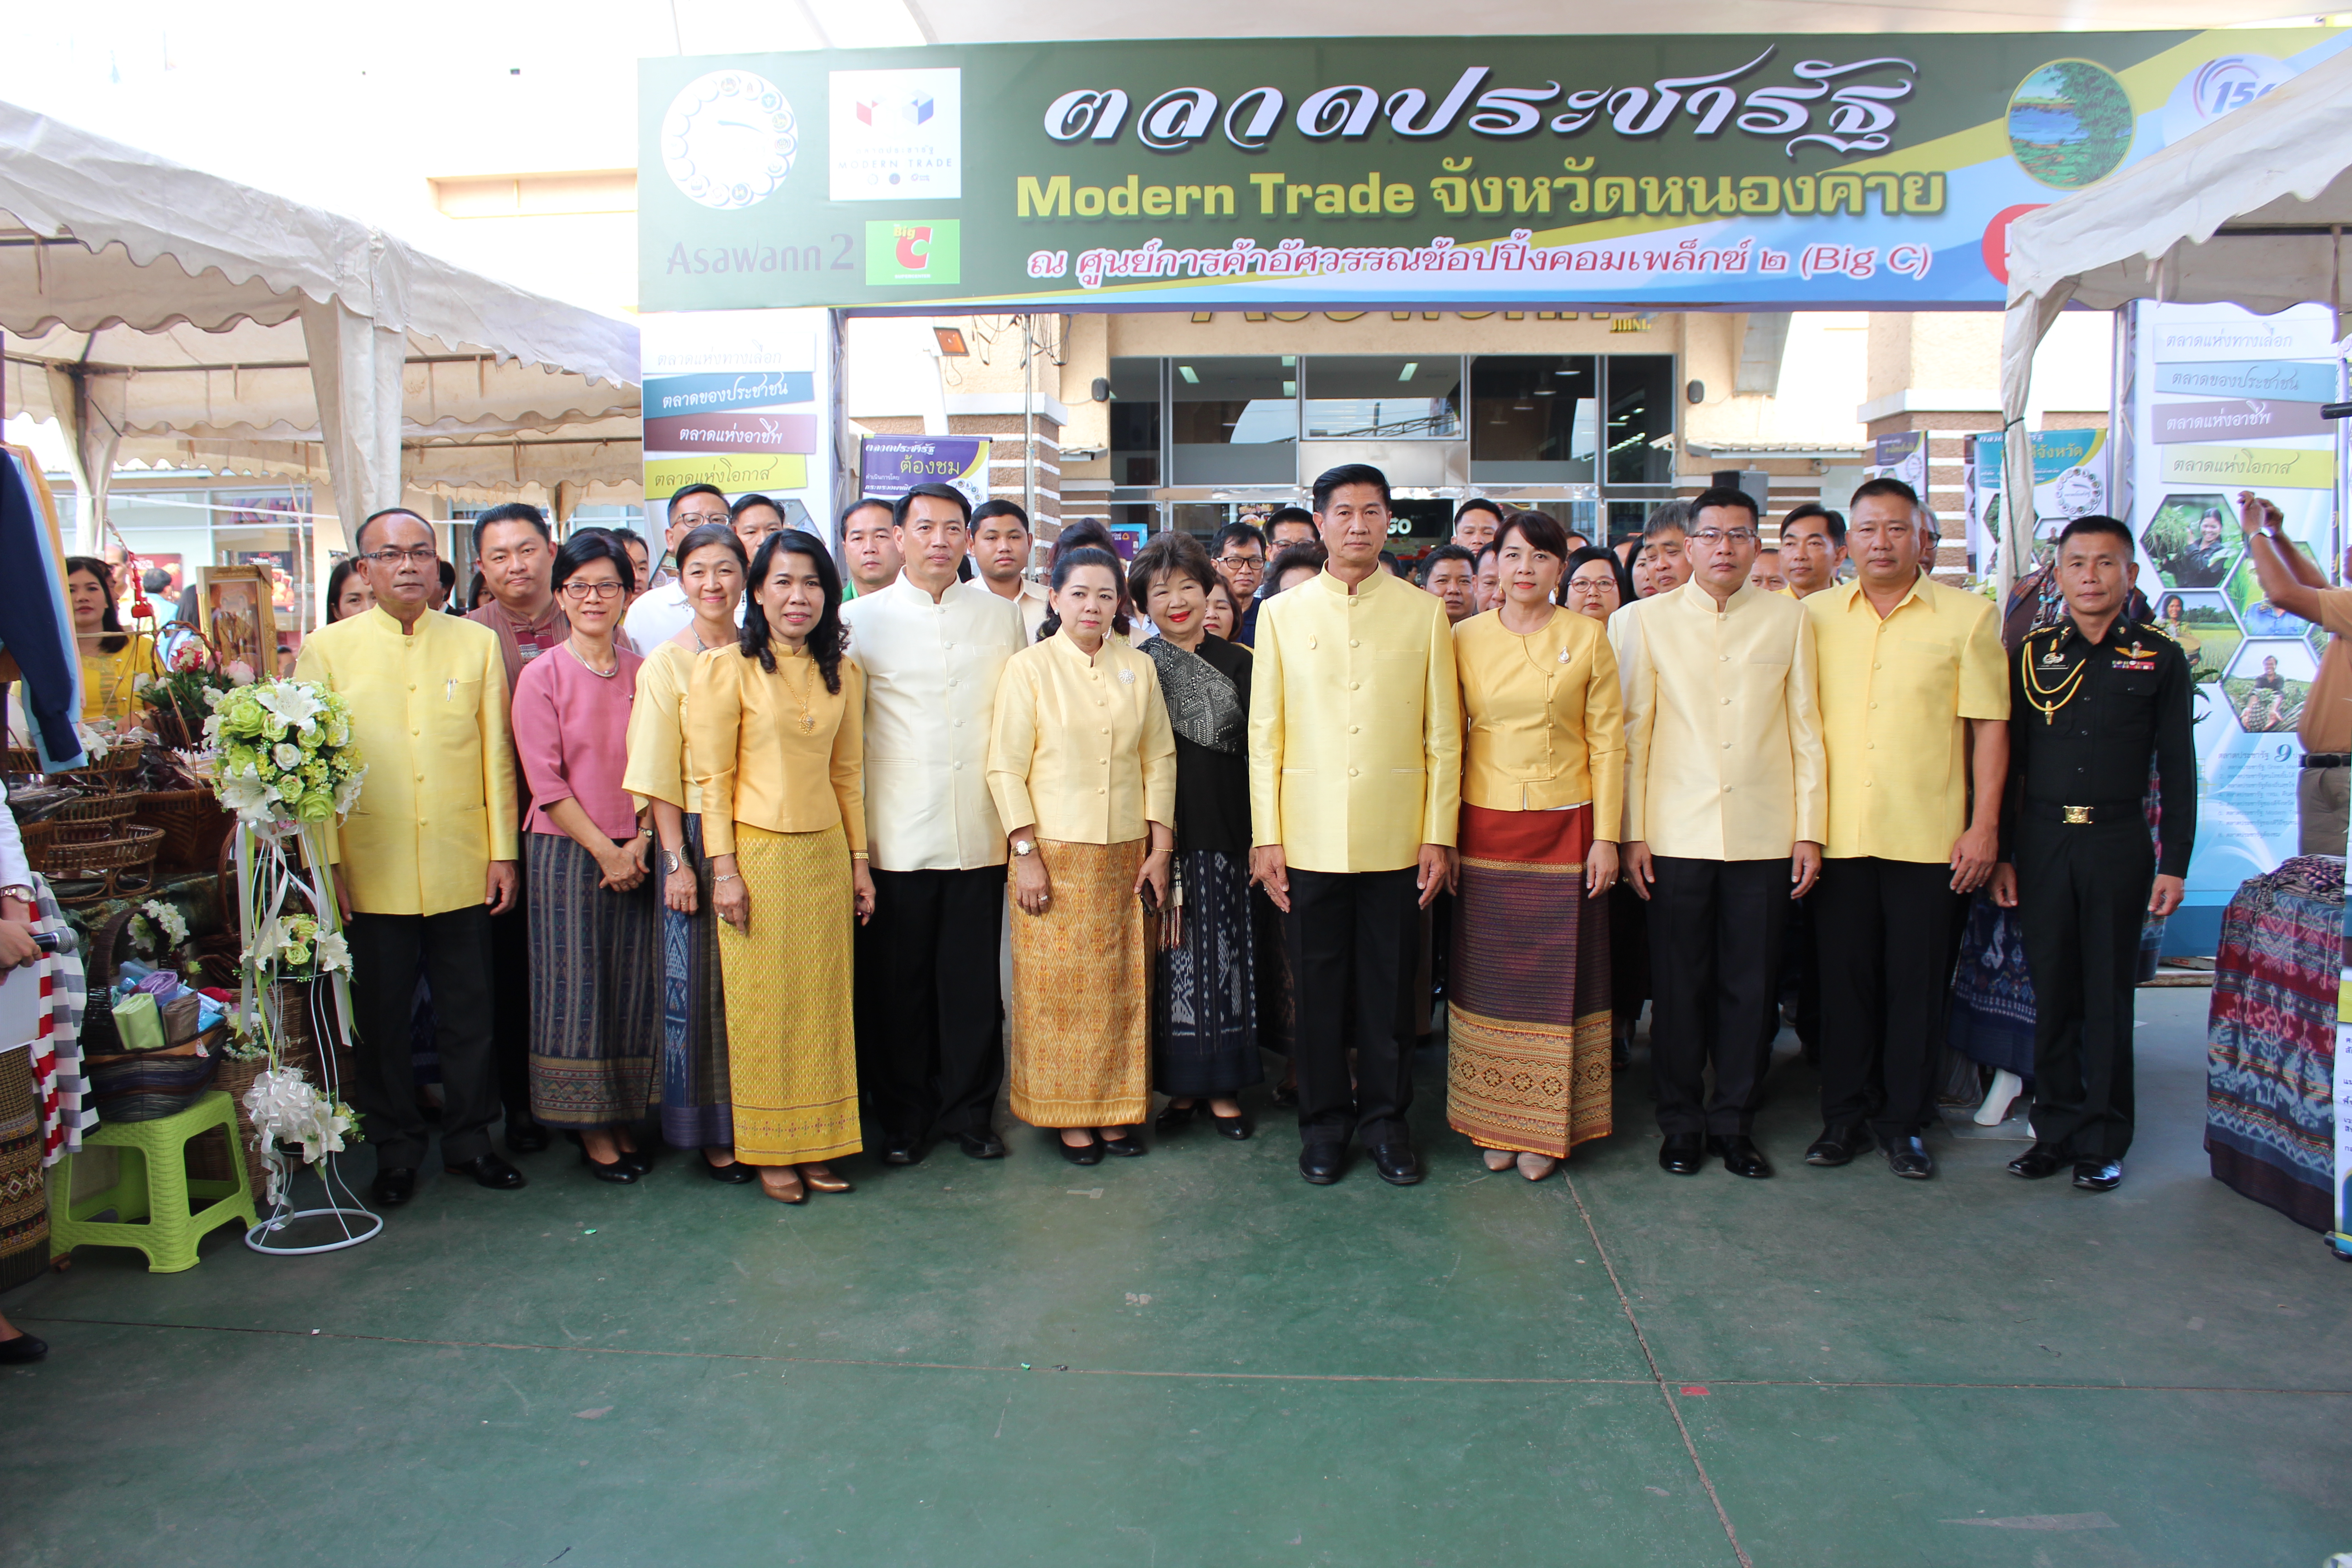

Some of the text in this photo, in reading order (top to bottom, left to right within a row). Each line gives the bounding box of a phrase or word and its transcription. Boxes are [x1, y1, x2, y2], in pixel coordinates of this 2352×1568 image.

[1044, 43, 1917, 157] ตลาดประชารัฐ
[838, 158, 952, 169] MODERN TRADE
[1017, 156, 1945, 217] Modern Trade จังหวัดหนองคาย
[666, 233, 854, 274] Asawann 2
[893, 225, 933, 270] Big C
[1029, 229, 1931, 286] ณ ศูนย์การค้าอัศวรรณช้อปปิ้งคอมเพล็กซ์ ๒ (Big C)
[2166, 322, 2292, 348] ตลาดแห่งทางเลือก
[657, 339, 781, 366] ตลาดแห่งทางเลือก
[662, 372, 788, 408] ตลาดของประชาชน
[2171, 366, 2299, 392] ตลาดของประชาชน
[680, 417, 783, 444] ตลาดแห่งอาชีพ
[2166, 400, 2272, 431] ตลาดแห่งอาชีพ
[655, 456, 778, 486] ตลาดแห่งโอกาส
[900, 455, 960, 475] ต้องชม
[2172, 448, 2299, 475] ตลาดแห่งโอกาส
